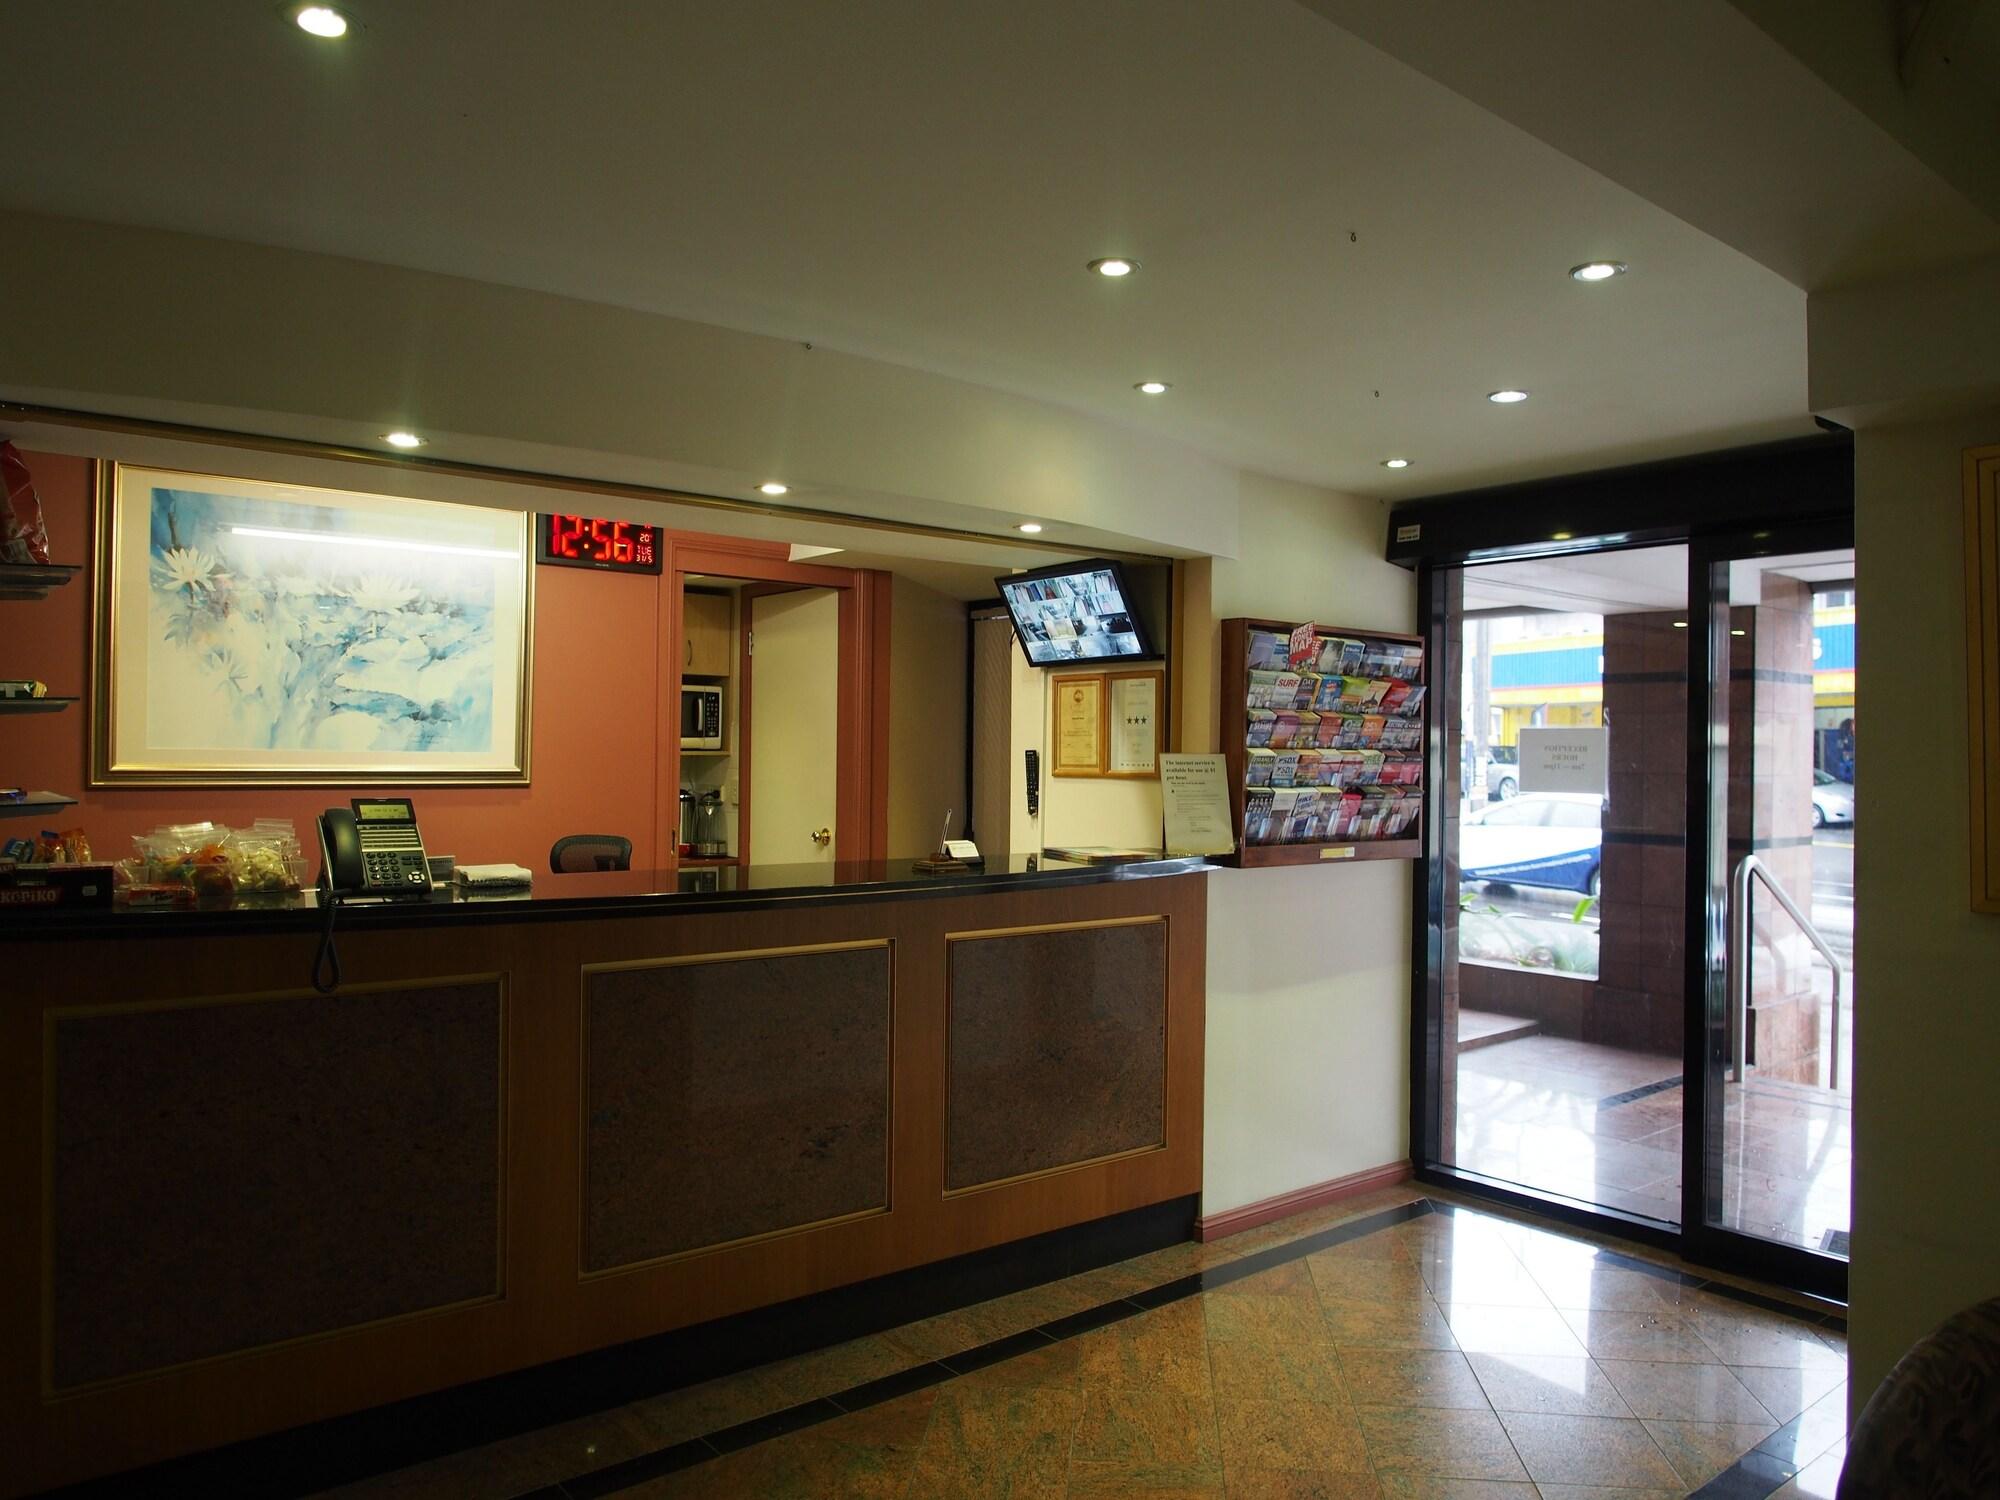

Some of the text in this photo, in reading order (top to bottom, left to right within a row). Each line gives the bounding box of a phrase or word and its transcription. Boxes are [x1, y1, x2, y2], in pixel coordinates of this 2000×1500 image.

[553, 513, 633, 563] 12:56
[637, 544, 652, 556] TUE
[1289, 636, 1313, 655] MAP
[1277, 678, 1299, 688] SURF
